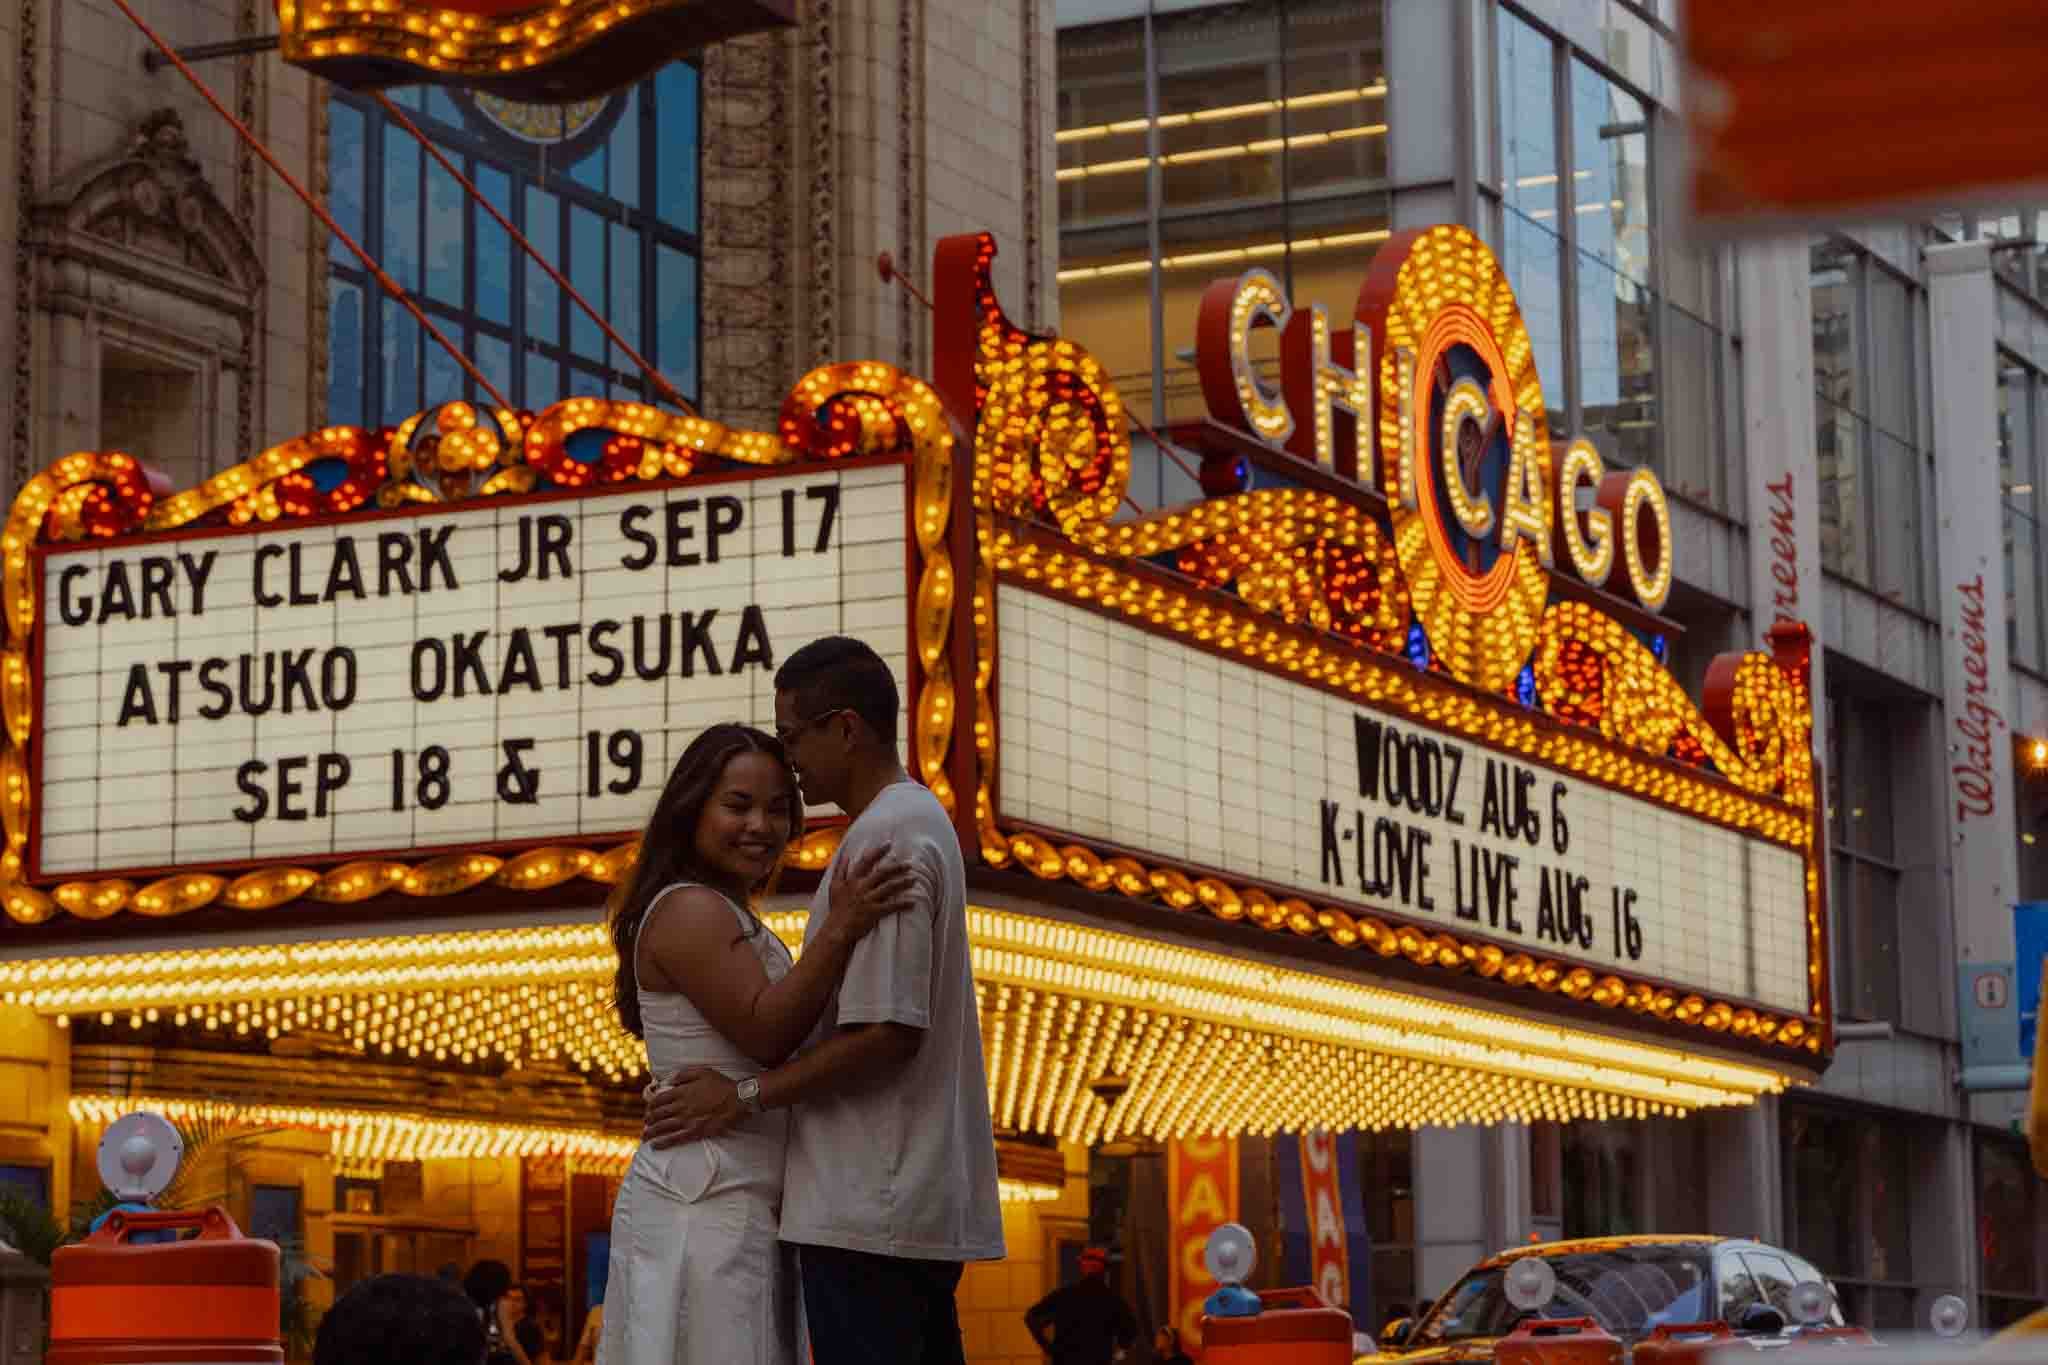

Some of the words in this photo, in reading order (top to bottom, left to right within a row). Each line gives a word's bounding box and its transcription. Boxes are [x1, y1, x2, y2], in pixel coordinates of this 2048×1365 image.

[1230, 267, 1673, 614] CHICAGO
[58, 549, 218, 626] GARY
[253, 526, 459, 608] CLARK
[498, 515, 573, 584] JR
[620, 496, 743, 572] SEP
[782, 484, 841, 558] 17
[117, 646, 358, 728] ATSUKO
[410, 605, 774, 704] OKATSUKA
[1952, 575, 2005, 822] Walgreens
[233, 751, 350, 823] SEP
[391, 745, 452, 812] 18
[497, 738, 540, 804] &
[587, 729, 644, 797] 19
[1354, 712, 1465, 825] WOODZ
[1480, 757, 1541, 846] AUG
[1551, 781, 1569, 855] 6
[1320, 798, 1435, 912] K-LOVE
[1452, 838, 1523, 935] LIVE
[1537, 865, 1593, 950] AUG
[1612, 886, 1643, 961] 16
